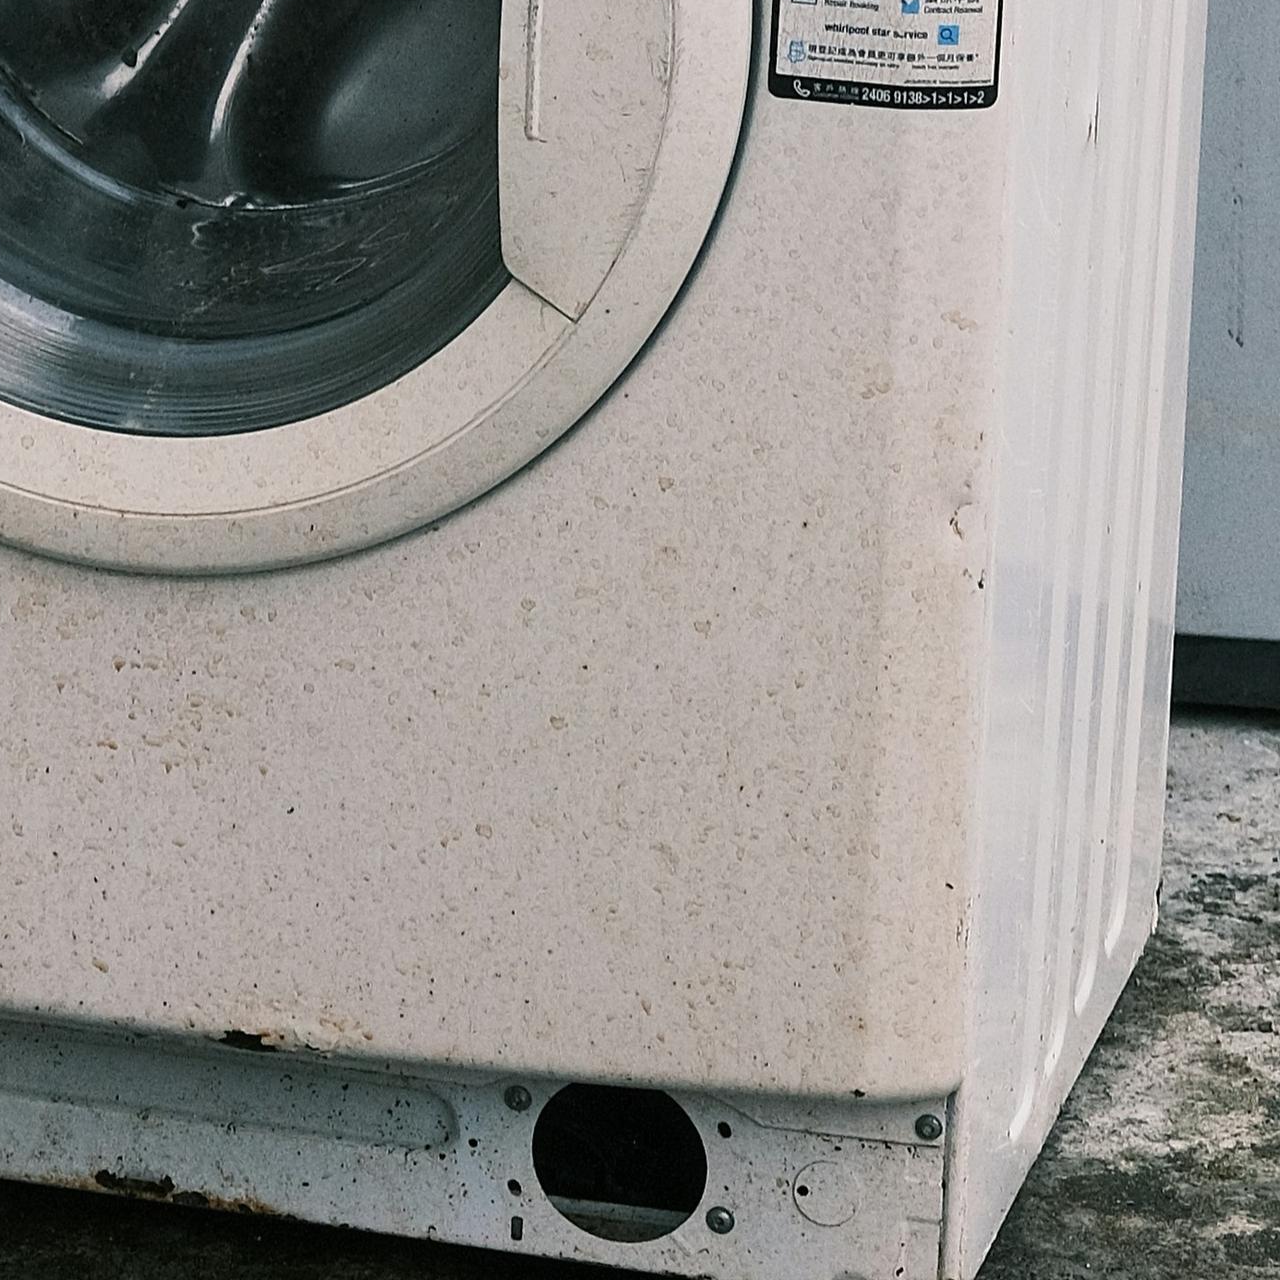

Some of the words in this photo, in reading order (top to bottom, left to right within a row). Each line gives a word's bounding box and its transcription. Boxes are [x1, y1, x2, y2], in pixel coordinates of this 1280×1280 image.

[825, 22, 870, 38] whirlpool
[872, 27, 891, 37] star
[862, 86, 891, 103] 2406
